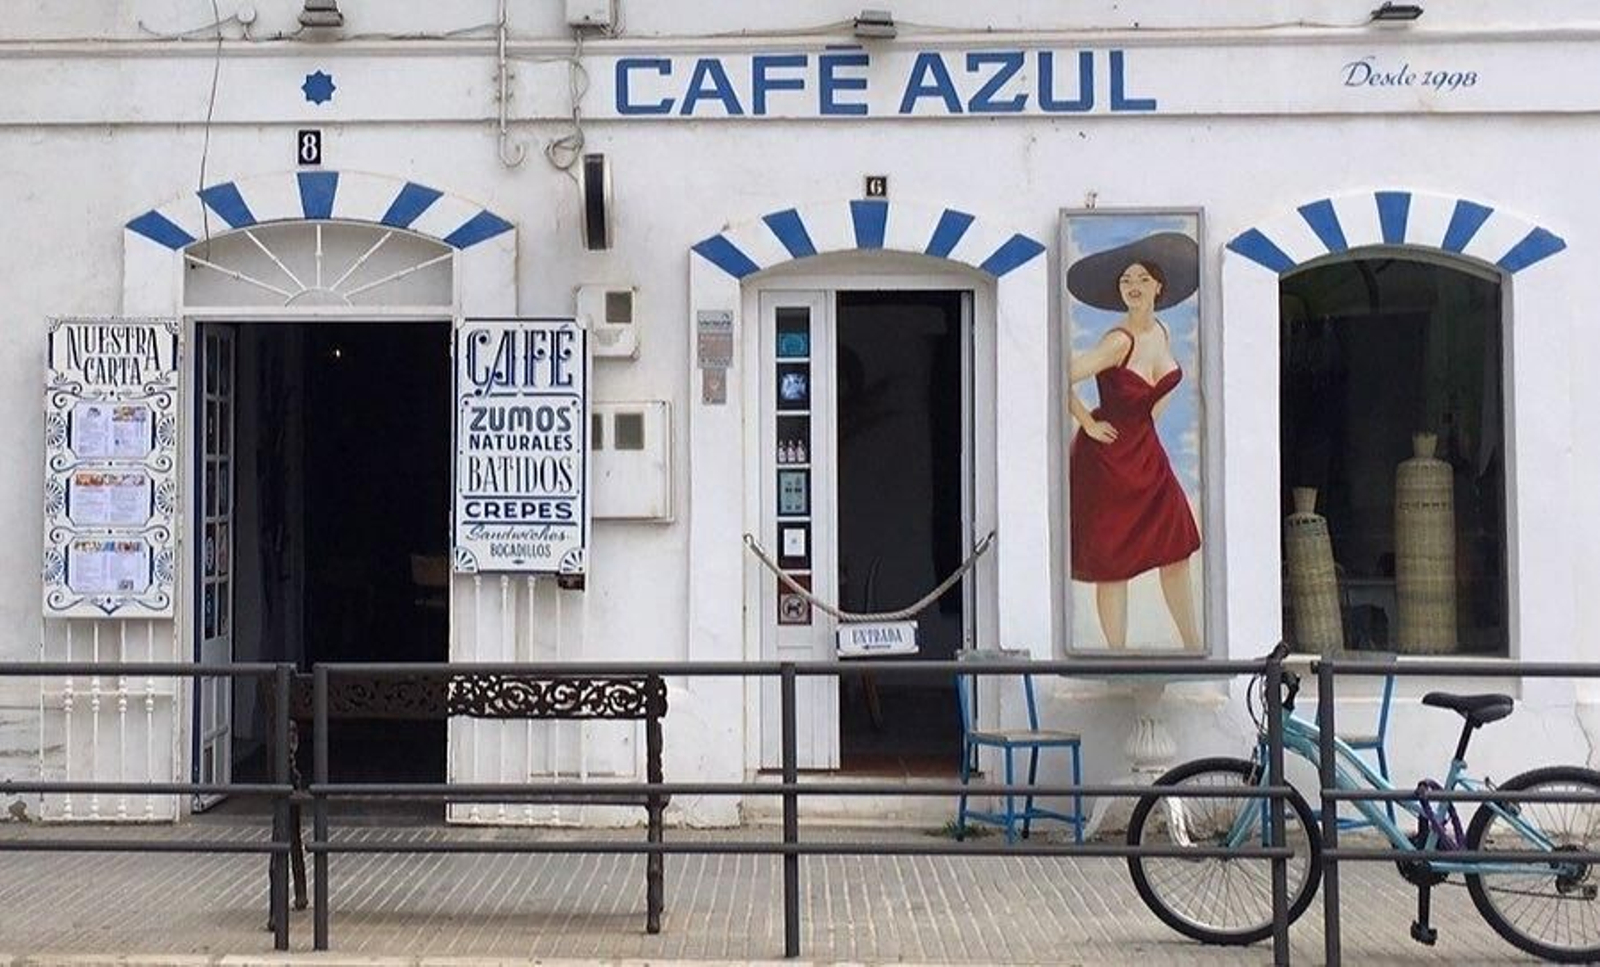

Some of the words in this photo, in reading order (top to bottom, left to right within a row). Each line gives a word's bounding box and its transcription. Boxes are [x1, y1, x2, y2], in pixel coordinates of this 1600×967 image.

[616, 45, 869, 115] CAFÉ
[899, 50, 1157, 114] AZUL
[1341, 56, 1417, 87] Desde
[1420, 70, 1478, 92] 1998
[301, 133, 318, 161] 8
[870, 179, 882, 195] 6
[66, 325, 161, 371] NUESTRA
[466, 324, 574, 396] CAFÉ
[84, 356, 142, 387] CARTA
[469, 406, 572, 432] ZUMOS
[469, 434, 573, 451] NATURALES
[468, 456, 573, 493] BATIDOS
[465, 502, 573, 519] CREPES
[466, 523, 566, 541] Sandwiches
[490, 543, 552, 558] BOCADILLOS
[852, 628, 903, 645] ENTRADA
